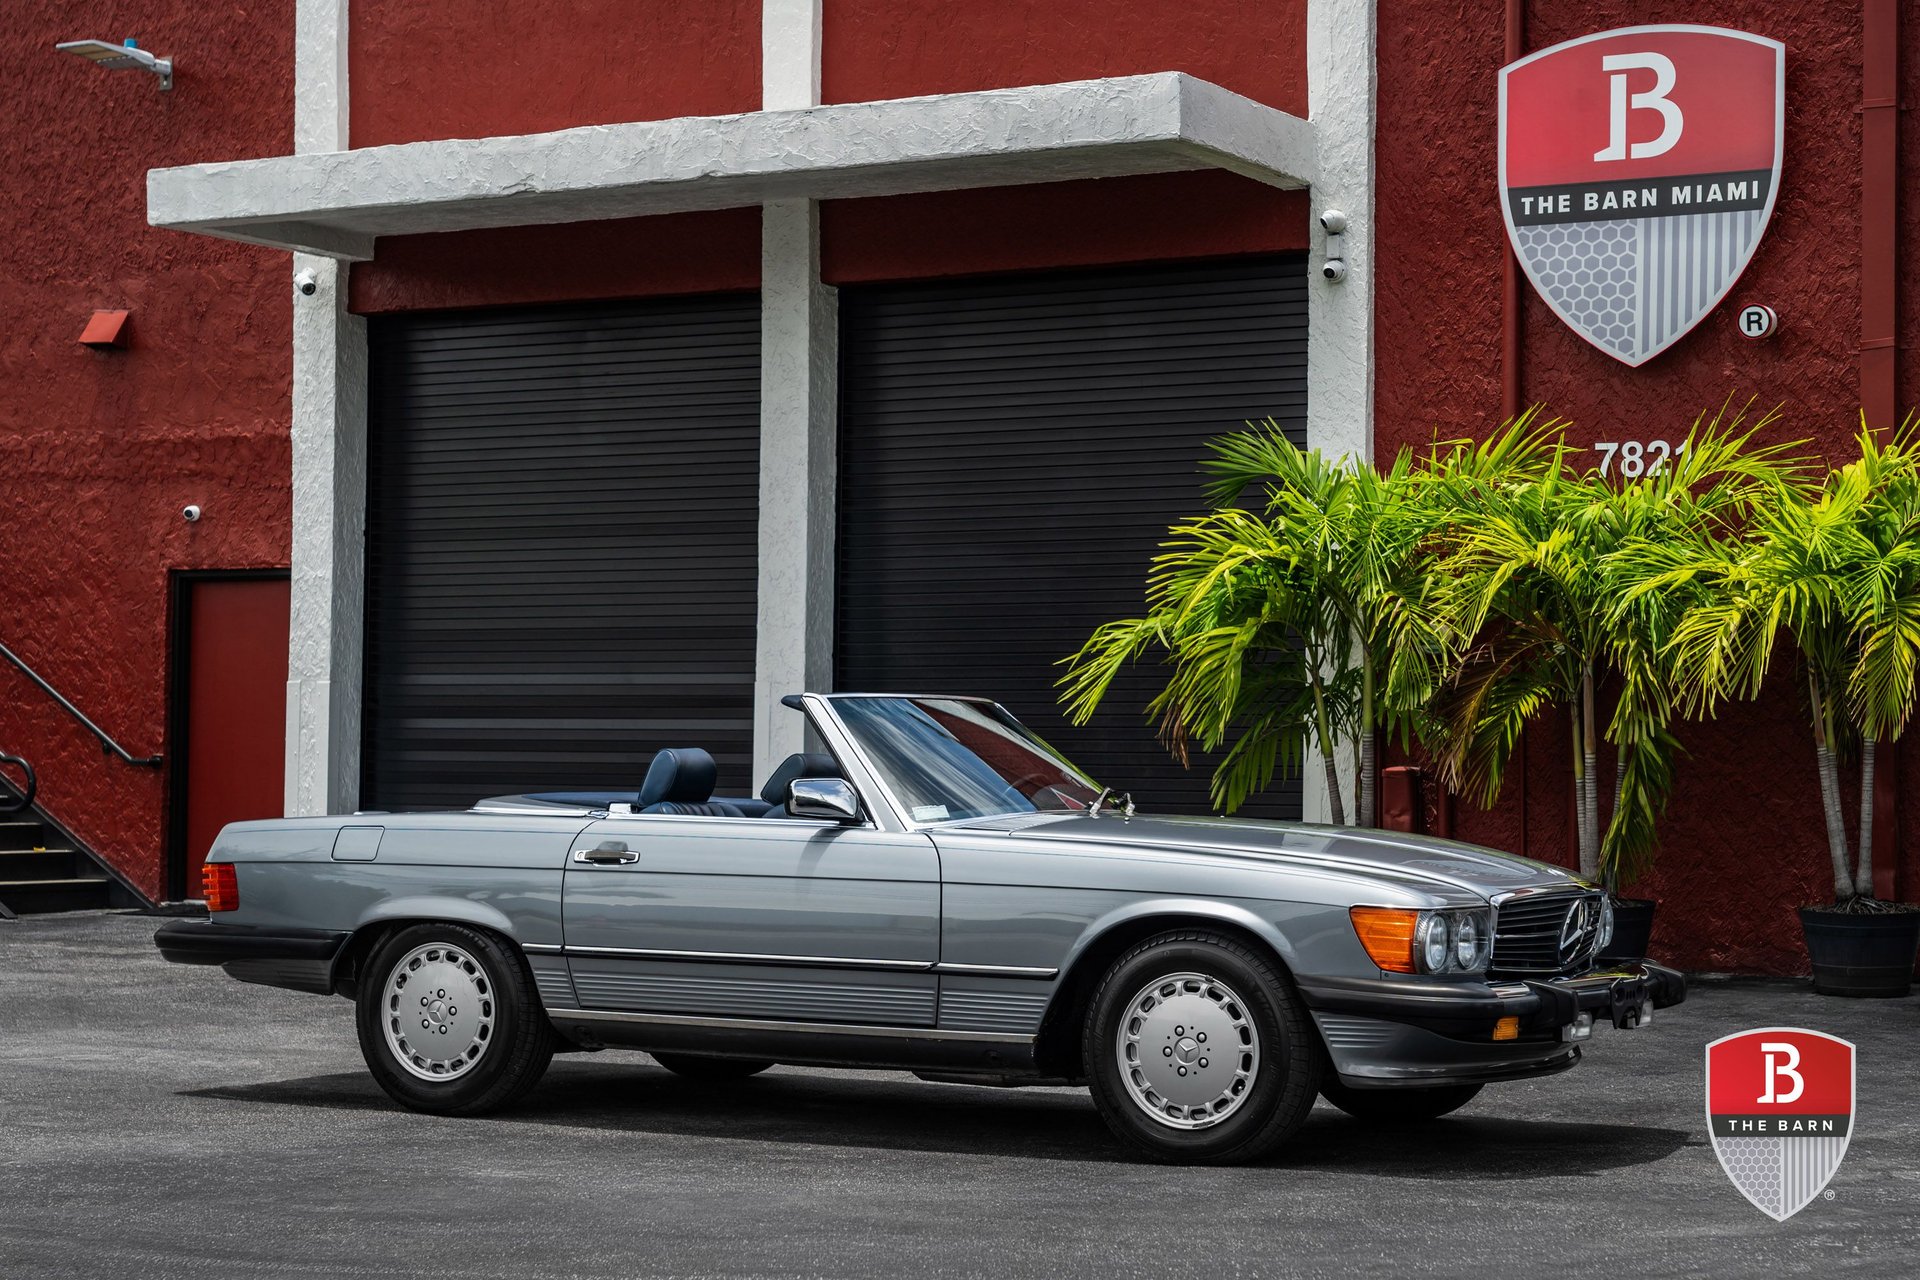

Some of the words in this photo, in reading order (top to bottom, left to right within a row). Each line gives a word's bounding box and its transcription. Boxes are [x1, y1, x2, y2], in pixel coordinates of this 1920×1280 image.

[1594, 52, 1684, 162] B
[1521, 194, 1571, 216] THE
[1584, 188, 1657, 211] BARN
[1672, 180, 1759, 205] MIAMI
